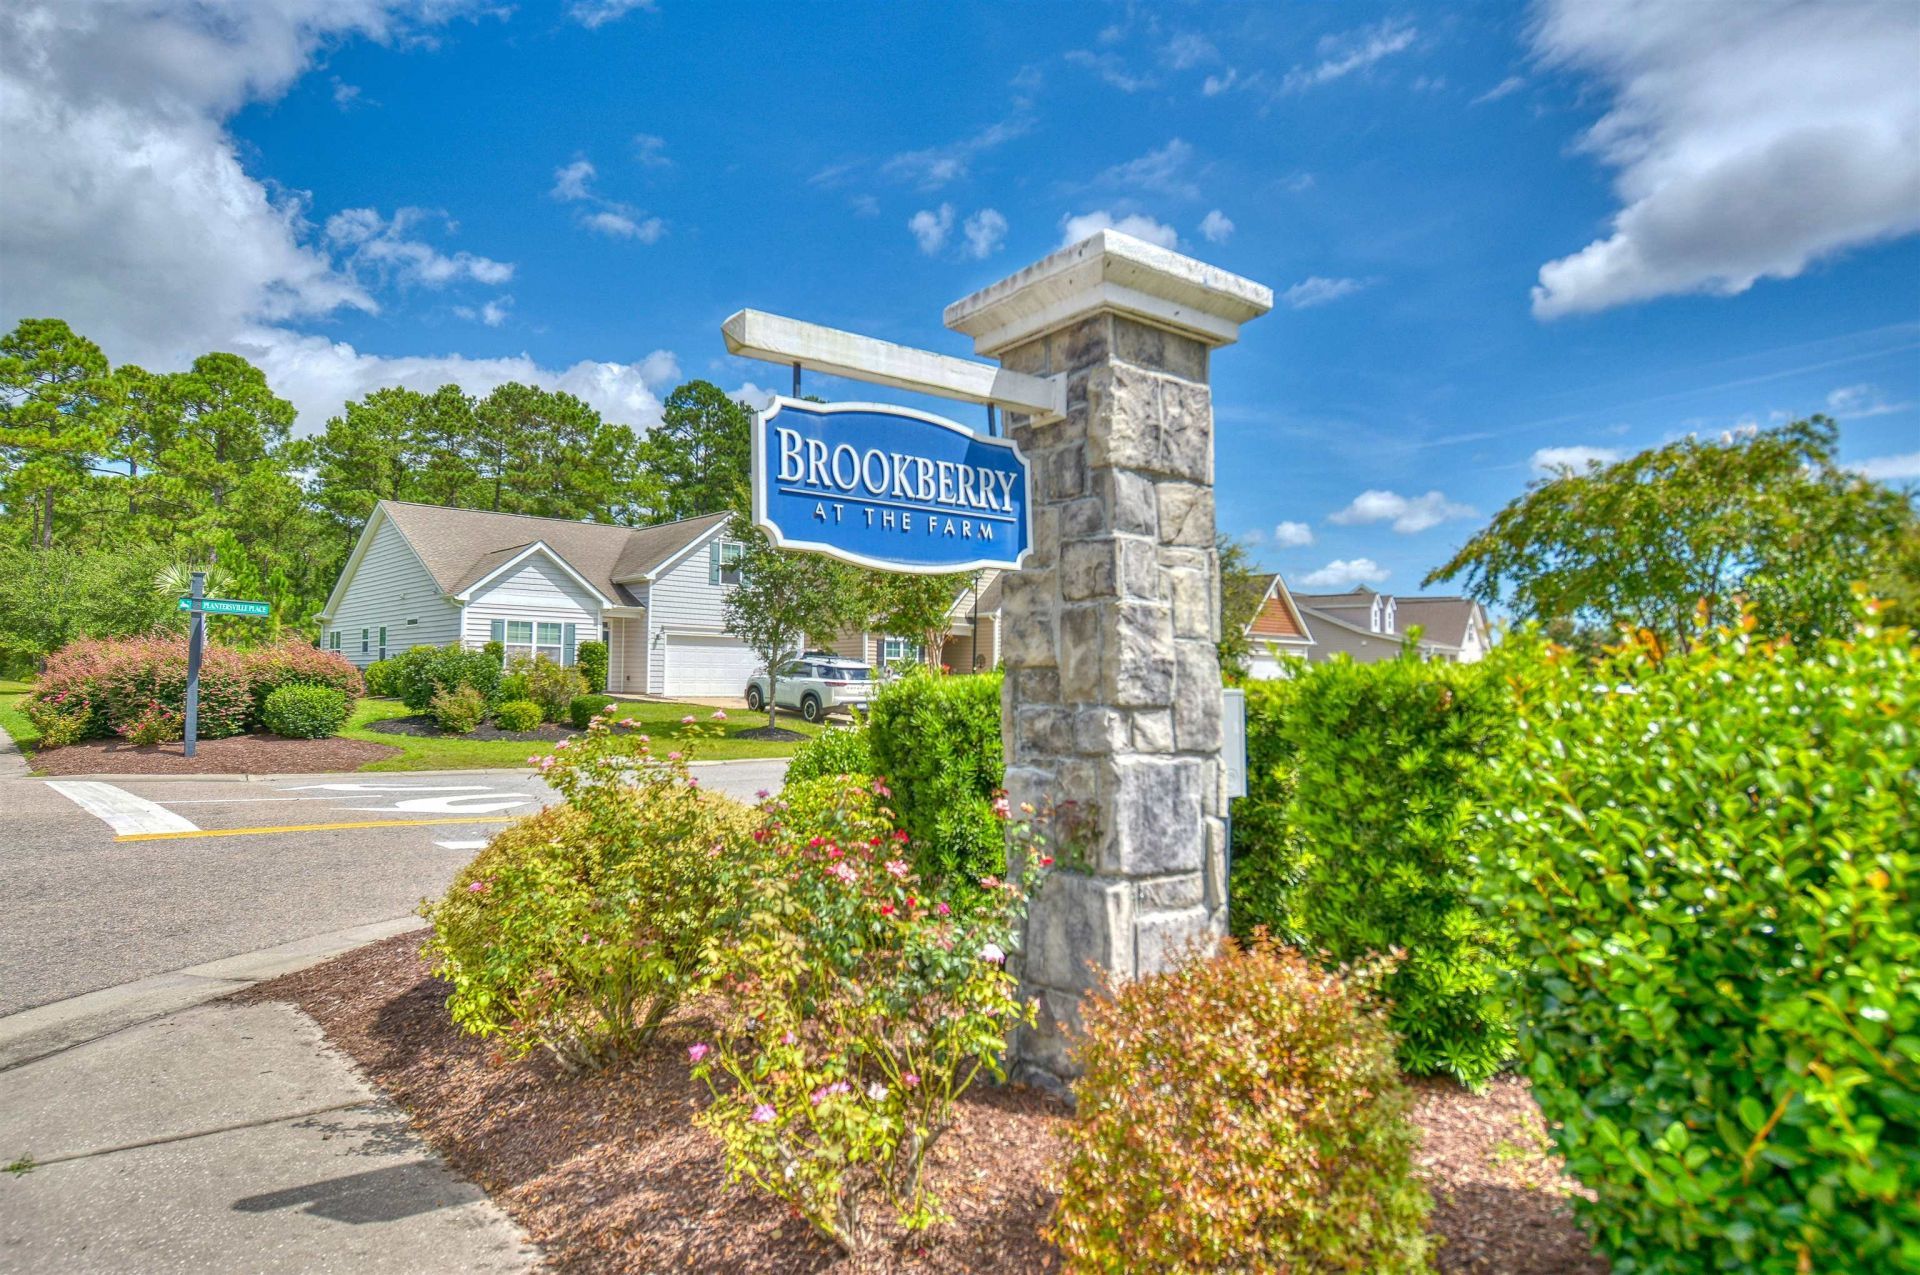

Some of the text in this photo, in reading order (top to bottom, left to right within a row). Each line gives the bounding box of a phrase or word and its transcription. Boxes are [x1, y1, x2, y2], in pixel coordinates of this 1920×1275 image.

[777, 427, 1017, 512] BROOKBERRY
[815, 502, 993, 539] AT THE FARM
[203, 601, 266, 613] PLANTERSVILLE PLACE
